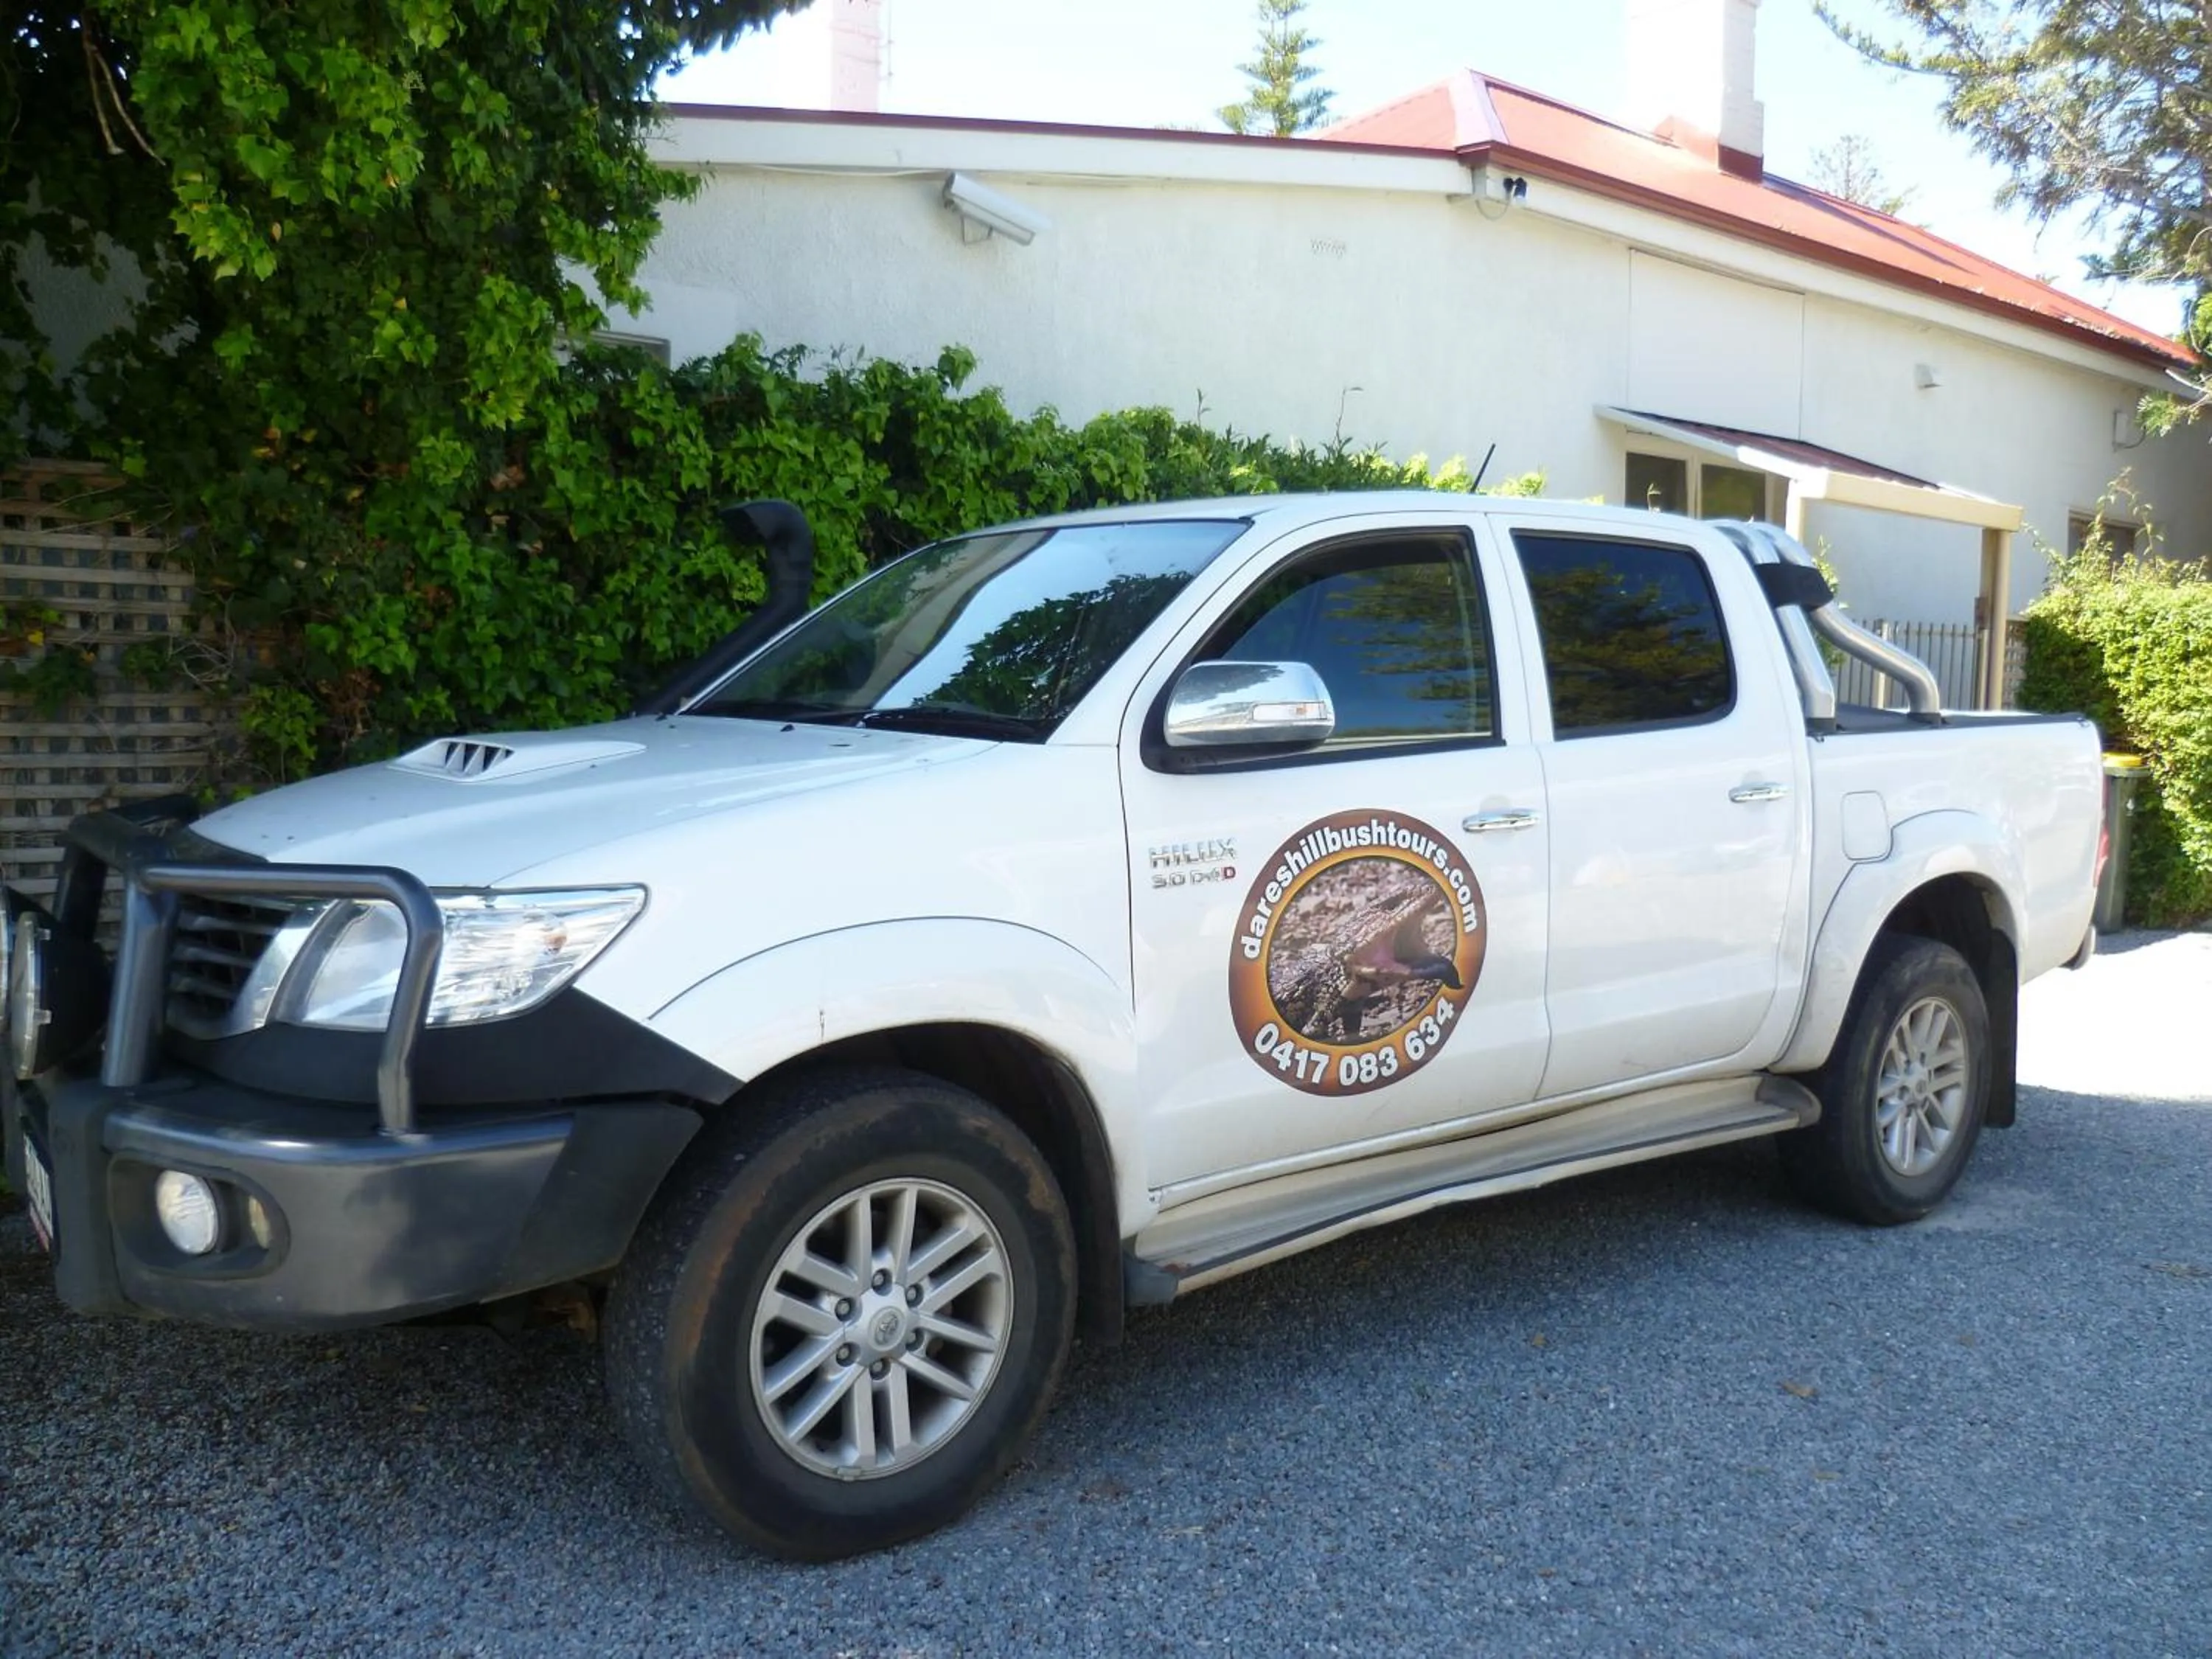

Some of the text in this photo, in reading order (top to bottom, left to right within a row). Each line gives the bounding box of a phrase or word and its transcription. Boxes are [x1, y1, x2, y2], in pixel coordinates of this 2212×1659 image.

[1149, 838, 1237, 868] HILUX
[1242, 819, 1477, 959] dareshillbushtours.com
[1255, 998, 1455, 1087] 0417 083 634
